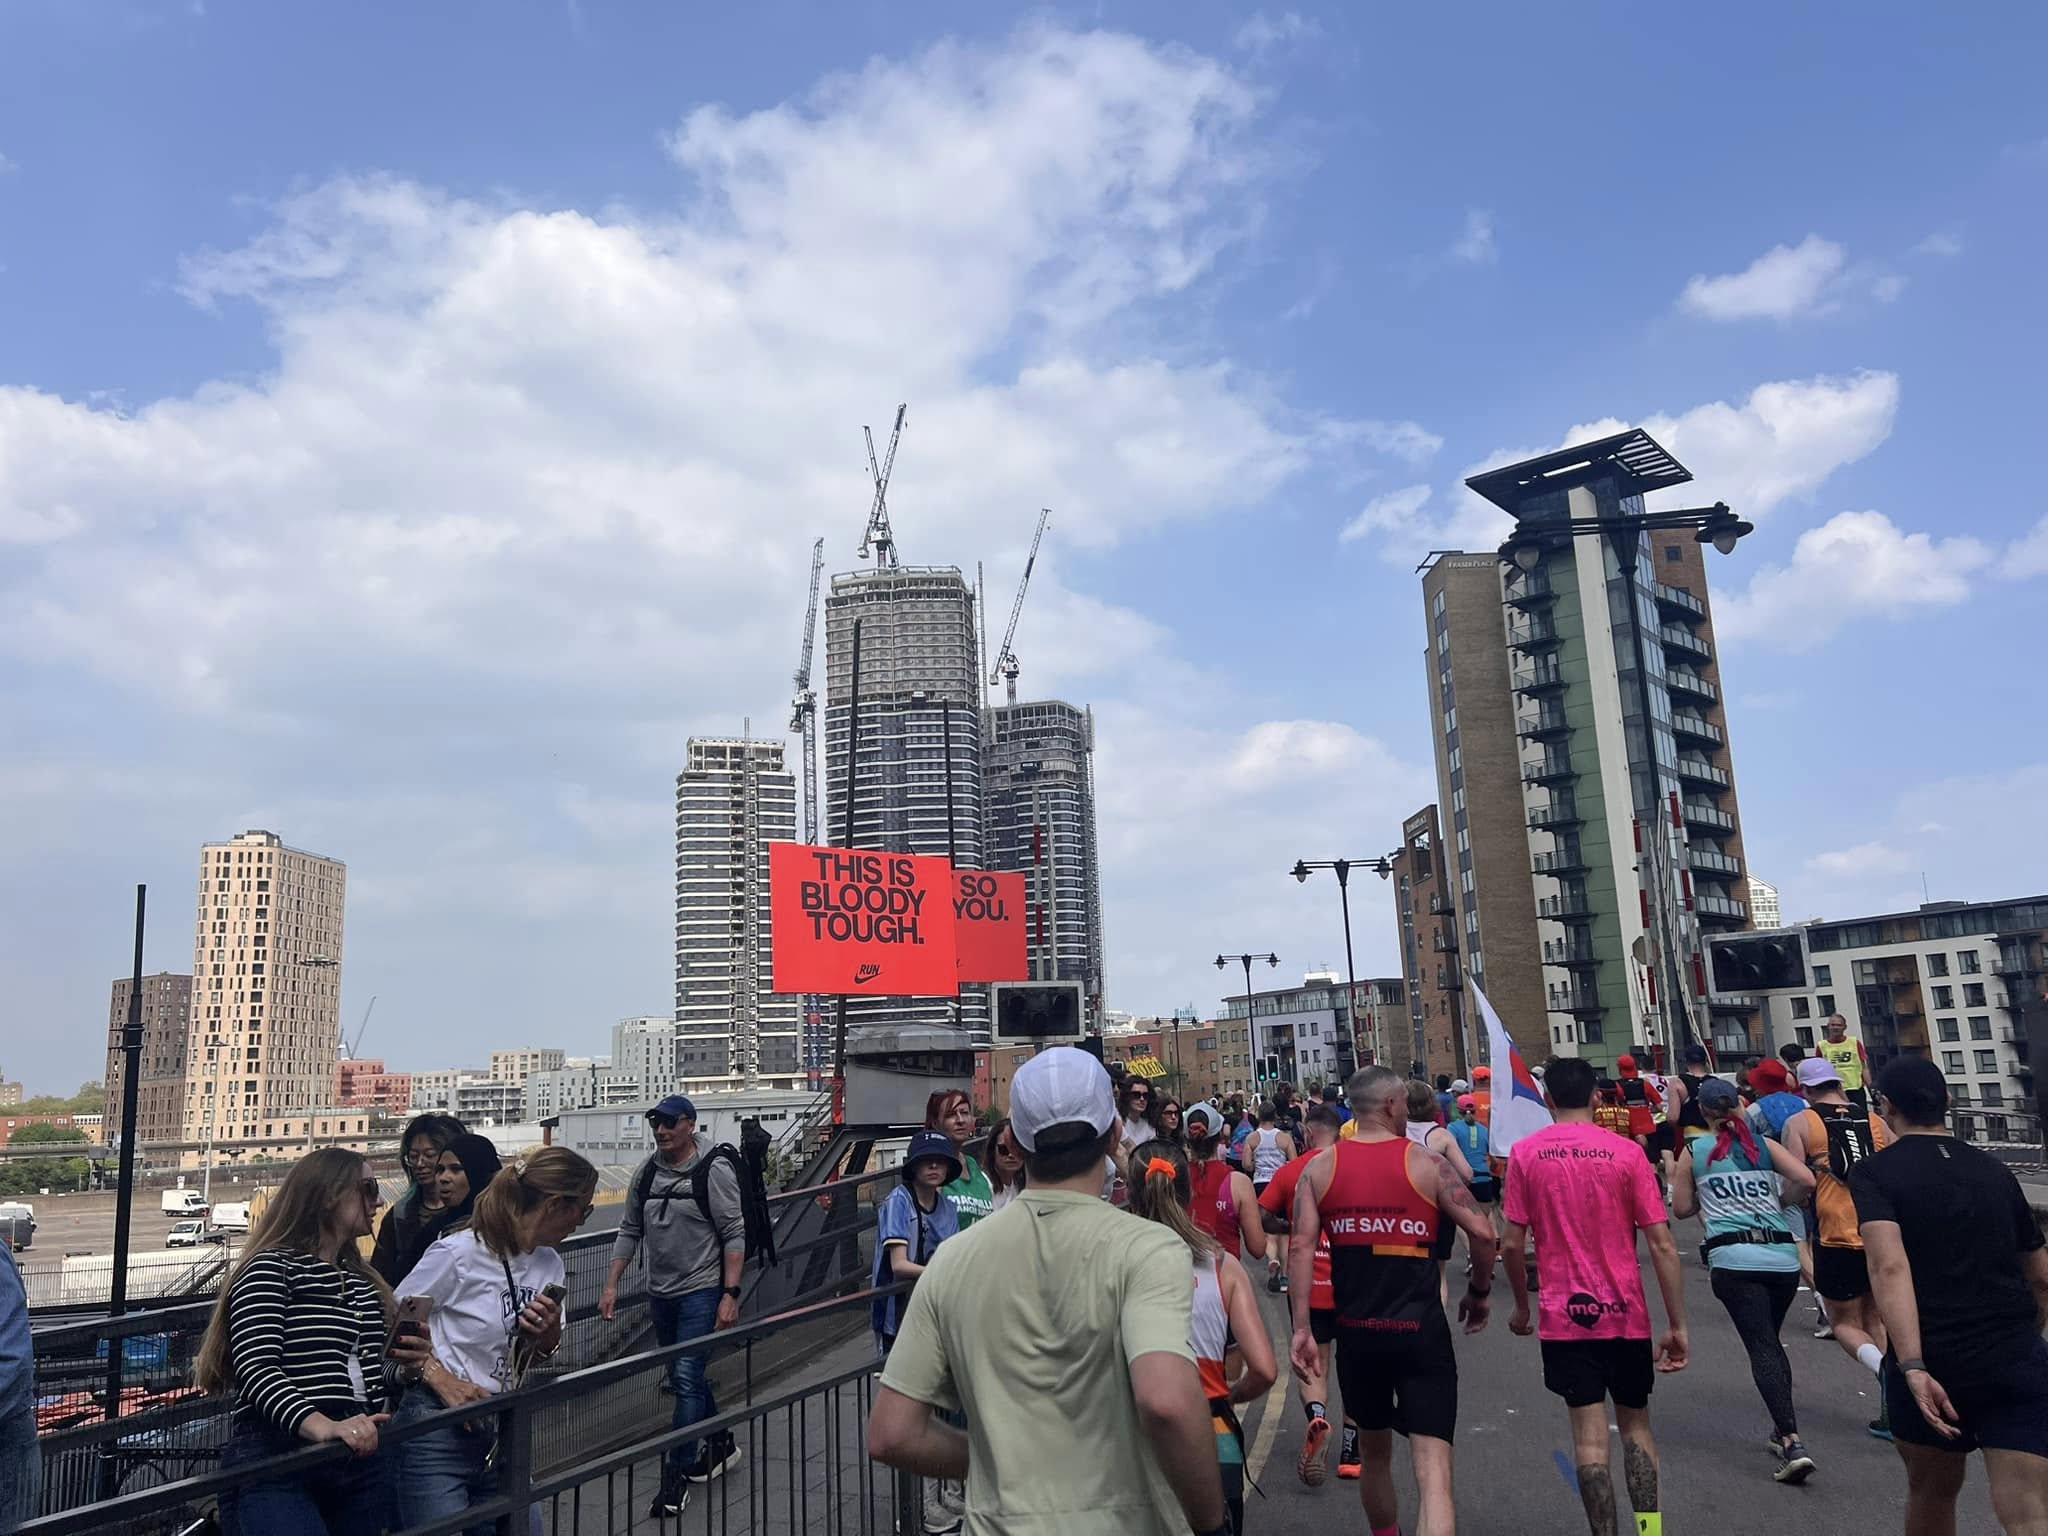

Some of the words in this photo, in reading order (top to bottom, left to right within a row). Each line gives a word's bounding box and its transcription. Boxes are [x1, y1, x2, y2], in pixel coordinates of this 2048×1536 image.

[812, 852, 882, 885] THIS
[889, 858, 915, 887] IS
[960, 875, 997, 898] SO
[801, 882, 926, 916] BLOODY
[953, 898, 1009, 921] YOU.
[807, 912, 924, 944] TOUGH.
[860, 964, 880, 975] RUN
[1572, 1148, 1614, 1161] Ruddy
[1709, 1176, 1769, 1199] Bliss
[1330, 1218, 1356, 1234] WE
[1360, 1217, 1396, 1233] SAY
[1400, 1219, 1429, 1237] GO.
